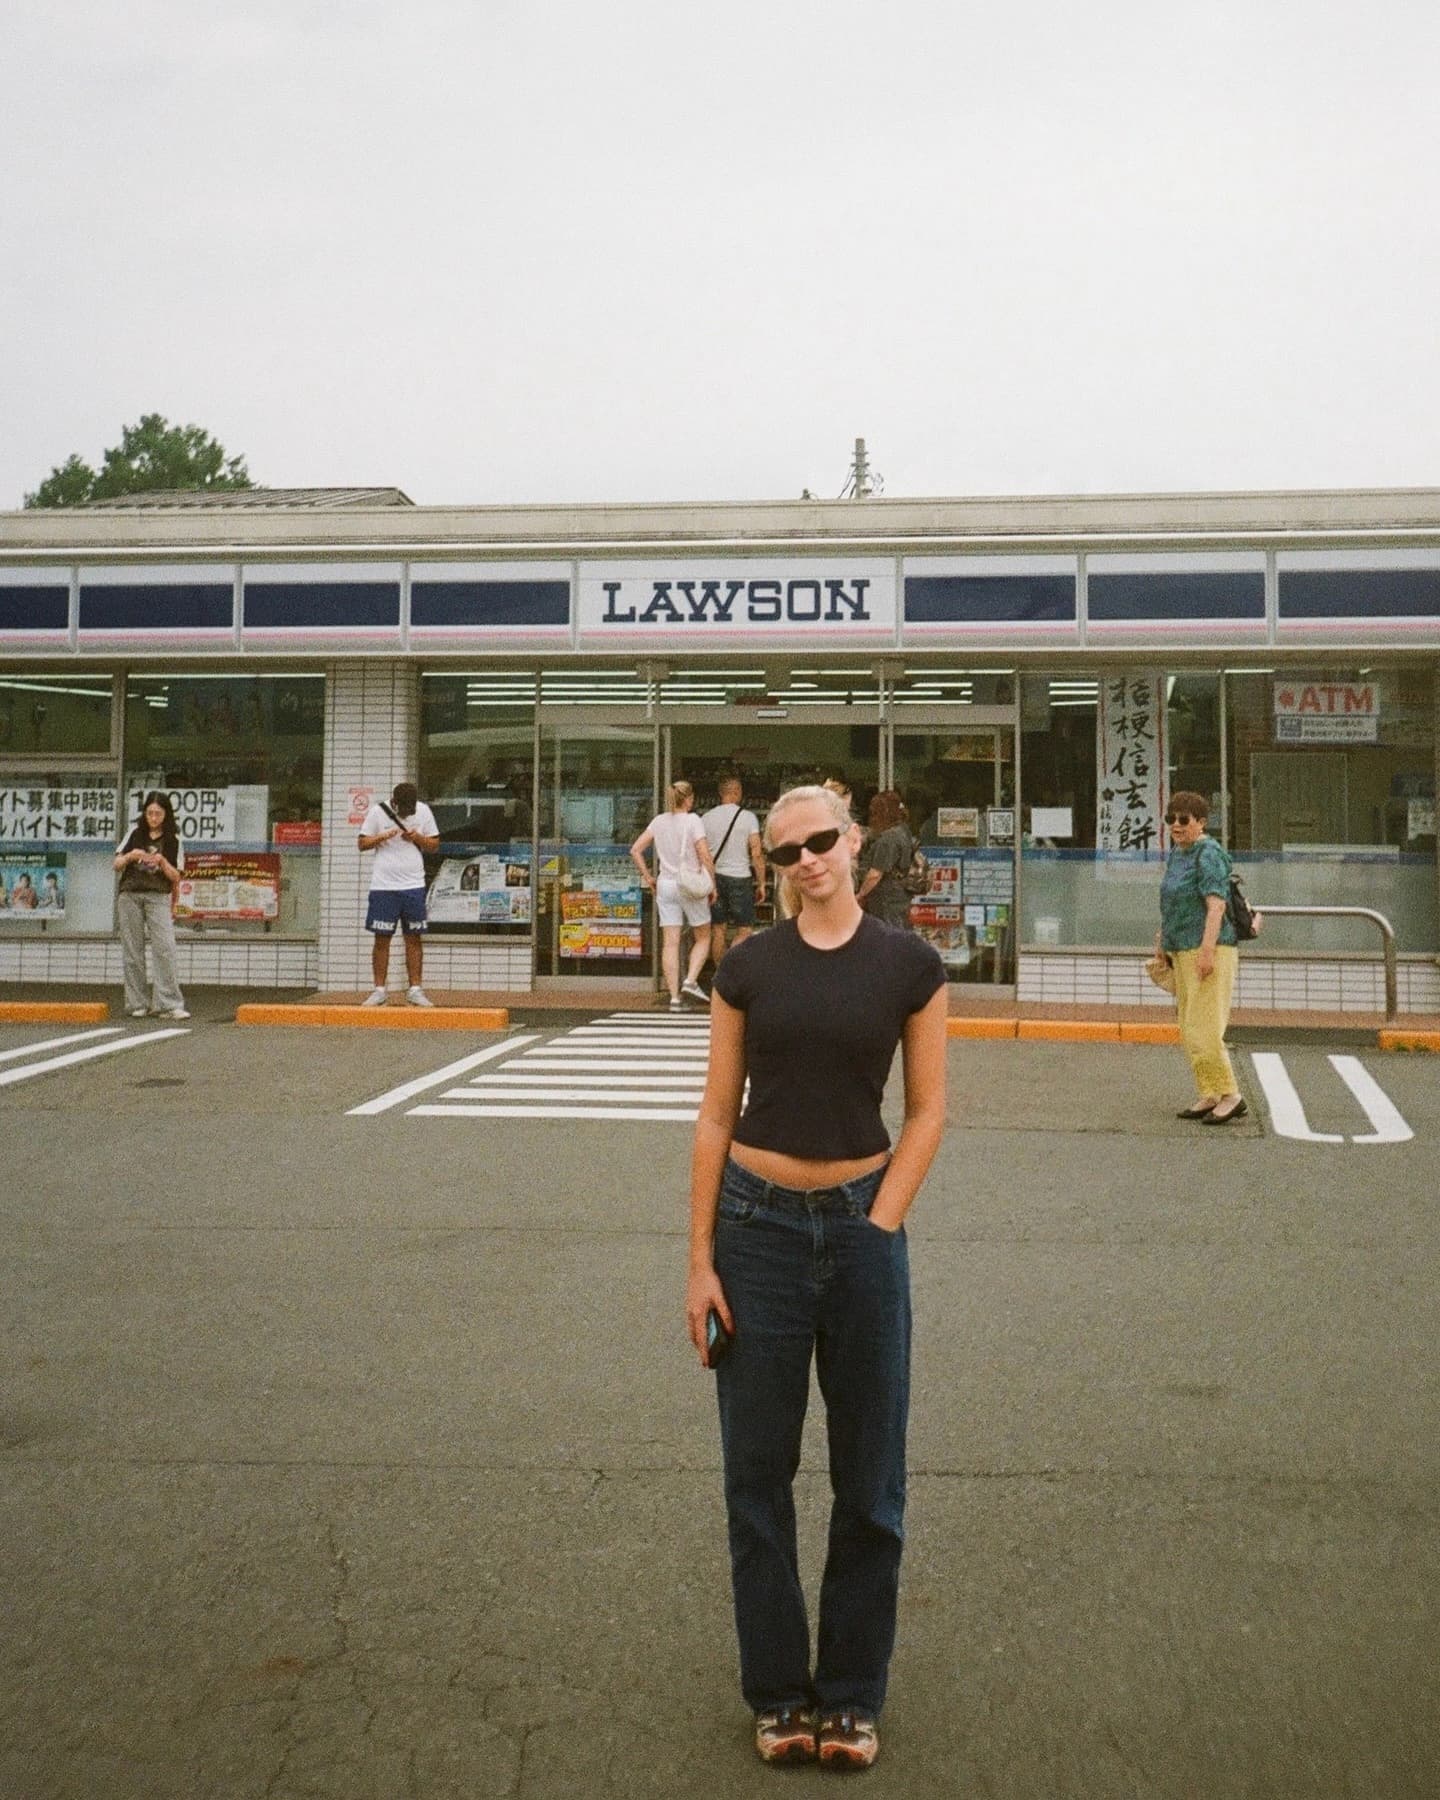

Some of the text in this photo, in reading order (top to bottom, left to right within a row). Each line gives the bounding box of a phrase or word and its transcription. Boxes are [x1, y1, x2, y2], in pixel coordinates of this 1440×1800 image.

[602, 579, 871, 623] LAWSON
[1299, 686, 1374, 713] ATM
[1109, 677, 1156, 863] 桔梗信玄餅
